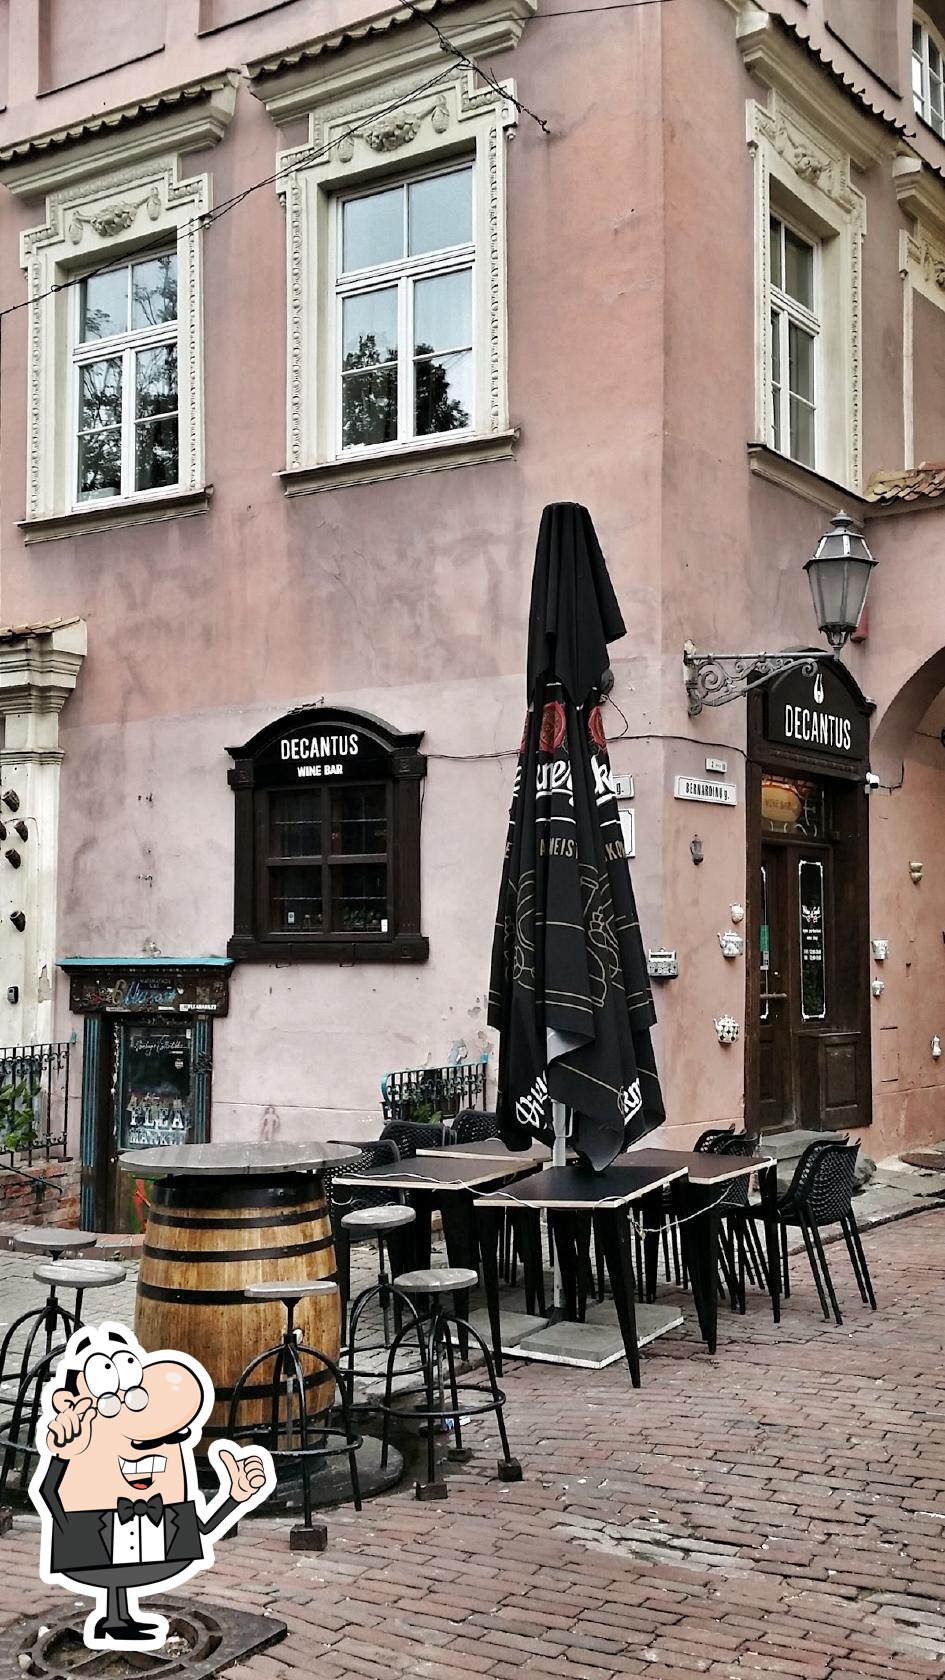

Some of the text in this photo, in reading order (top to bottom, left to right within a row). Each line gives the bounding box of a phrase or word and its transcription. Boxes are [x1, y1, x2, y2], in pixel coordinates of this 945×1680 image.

[785, 705, 851, 750] DECANTUS
[281, 734, 358, 760] DECANTUS
[297, 764, 343, 777] WINE BAR
[130, 1105, 184, 1129] FLEA
